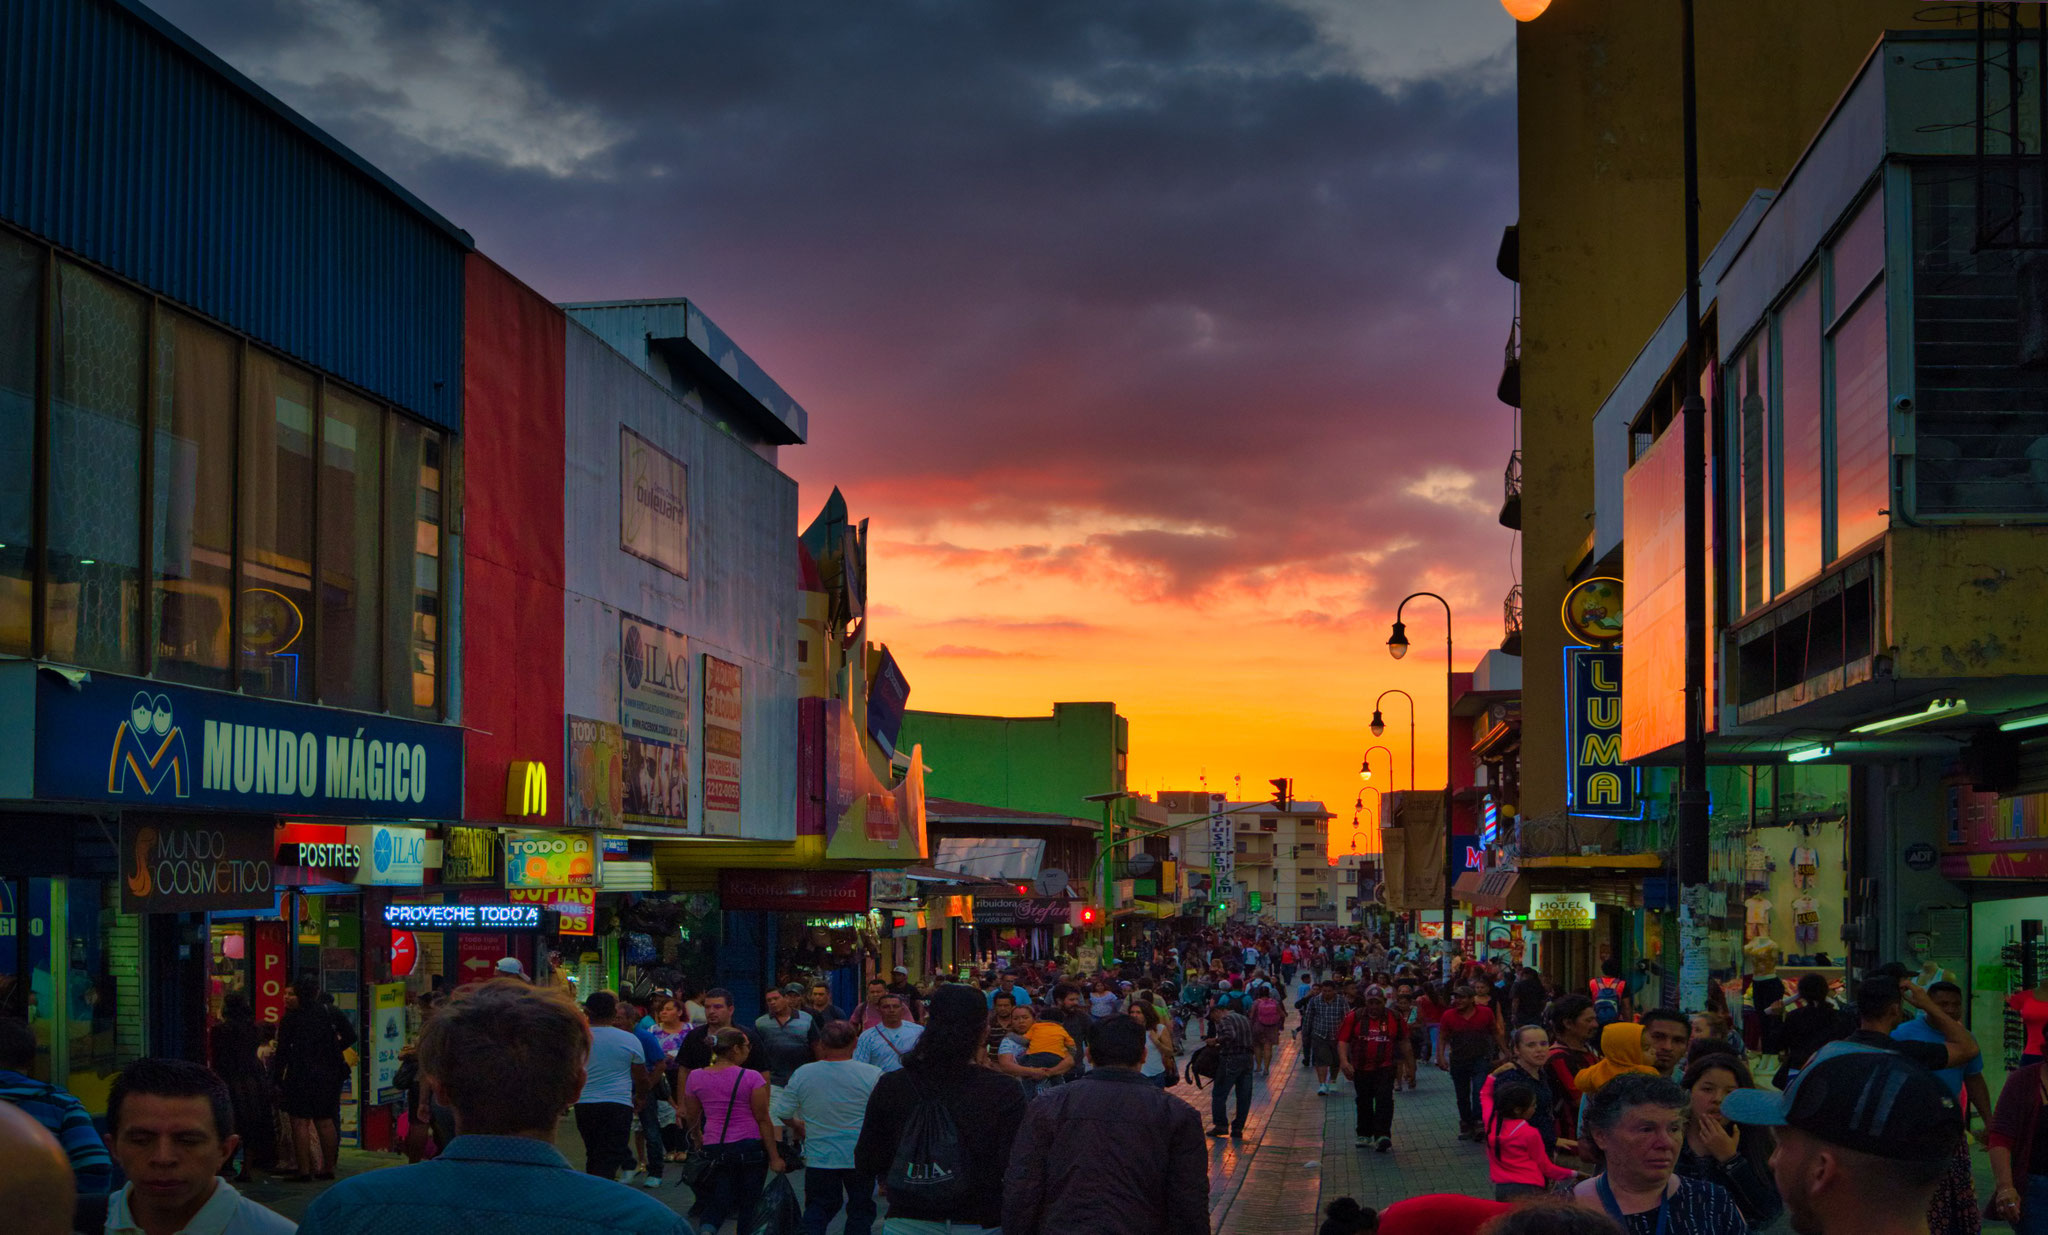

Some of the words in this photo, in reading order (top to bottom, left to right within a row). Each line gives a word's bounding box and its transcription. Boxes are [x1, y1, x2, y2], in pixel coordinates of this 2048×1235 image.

[644, 643, 687, 693] ILAC
[571, 721, 597, 742] TODO
[599, 724, 606, 742] A
[1579, 660, 1628, 804] LUMA
[202, 720, 317, 798] MUNDO
[326, 728, 426, 803] MÁGICO
[158, 830, 225, 859] MUNDO
[299, 843, 361, 867] POSTRES
[392, 836, 425, 864] ILAC
[510, 840, 567, 855] TODO
[573, 840, 588, 853] A
[1908, 851, 1933, 862] ADT
[479, 906, 522, 921] TODO
[1535, 908, 1589, 919] DORADO
[1540, 901, 1583, 909] HOTEL
[0, 917, 44, 937] GIO
